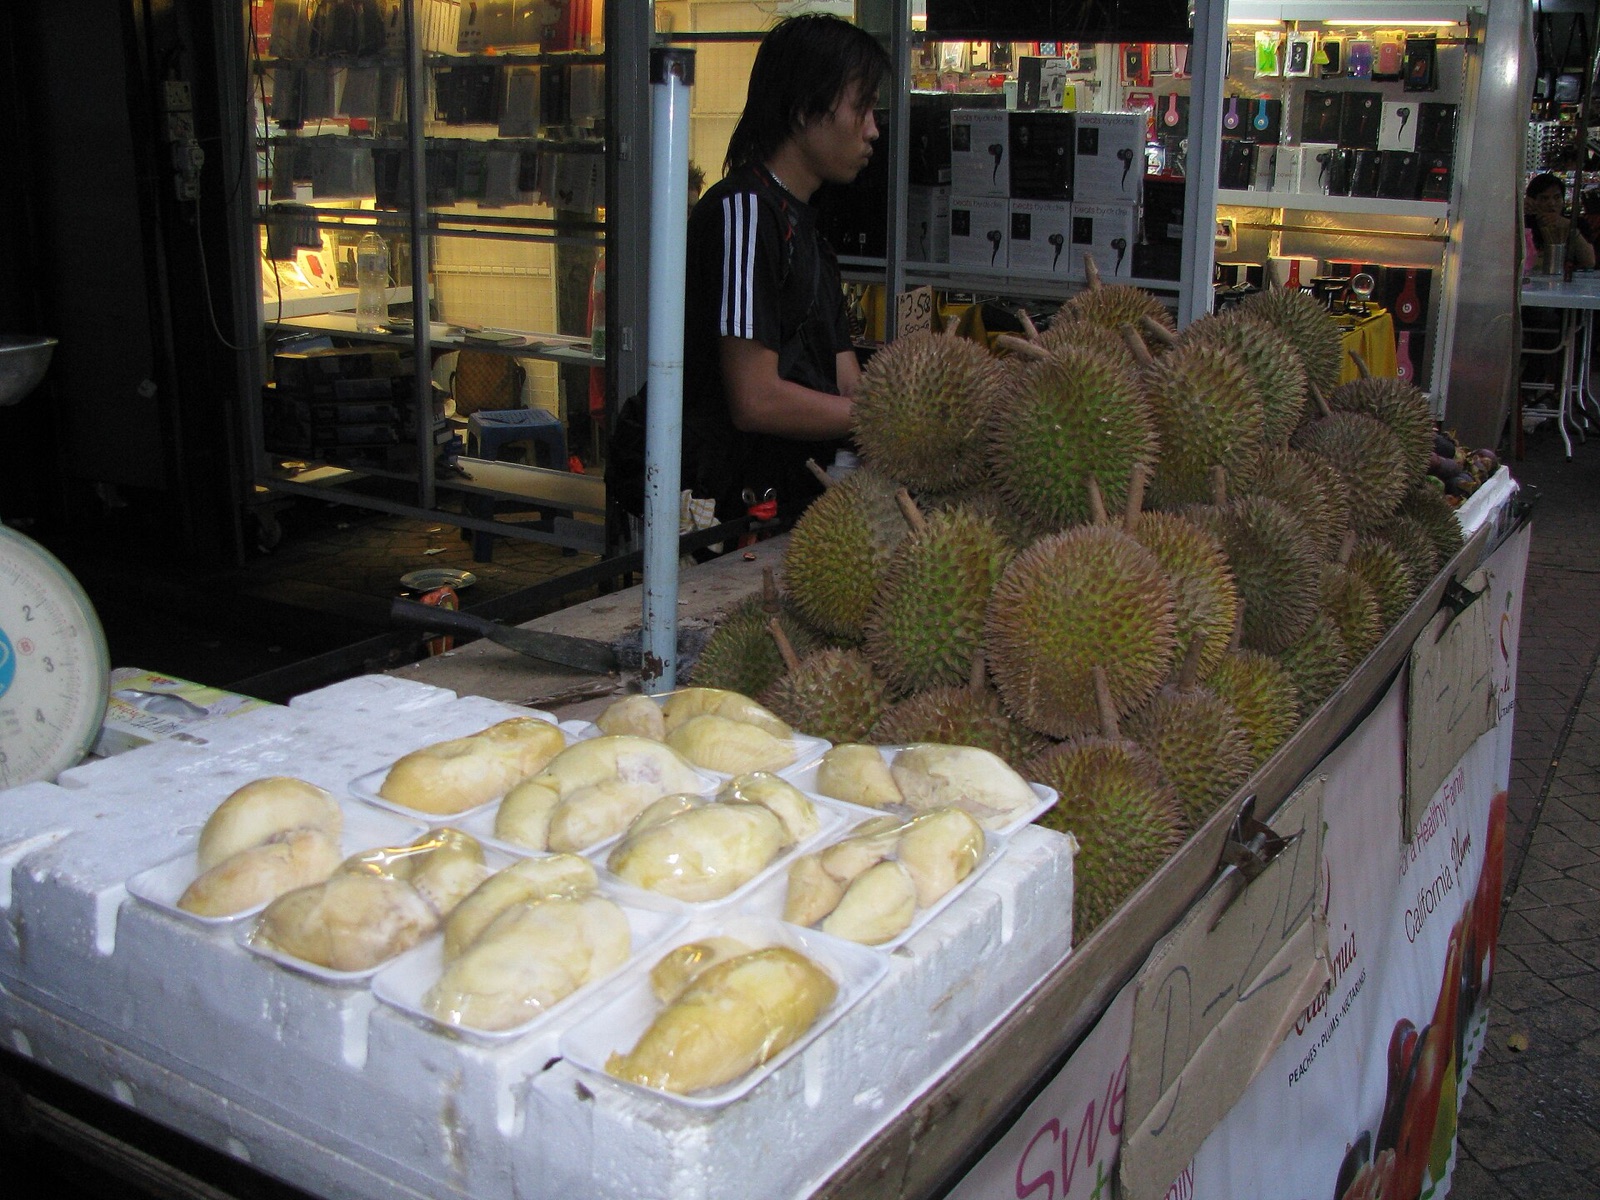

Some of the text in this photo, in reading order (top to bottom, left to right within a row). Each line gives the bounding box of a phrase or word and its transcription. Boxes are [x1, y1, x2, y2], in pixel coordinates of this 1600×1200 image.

[1079, 115, 1101, 124] beats
[1012, 202, 1034, 210] beats
[1074, 205, 1095, 213] beats
[22, 604, 35, 622] 2
[43, 656, 54, 673] 3
[36, 708, 46, 724] 4
[1404, 863, 1453, 944] California
[1288, 1044, 1318, 1087] PEACHES
[1320, 1013, 1340, 1049] PLUMS
